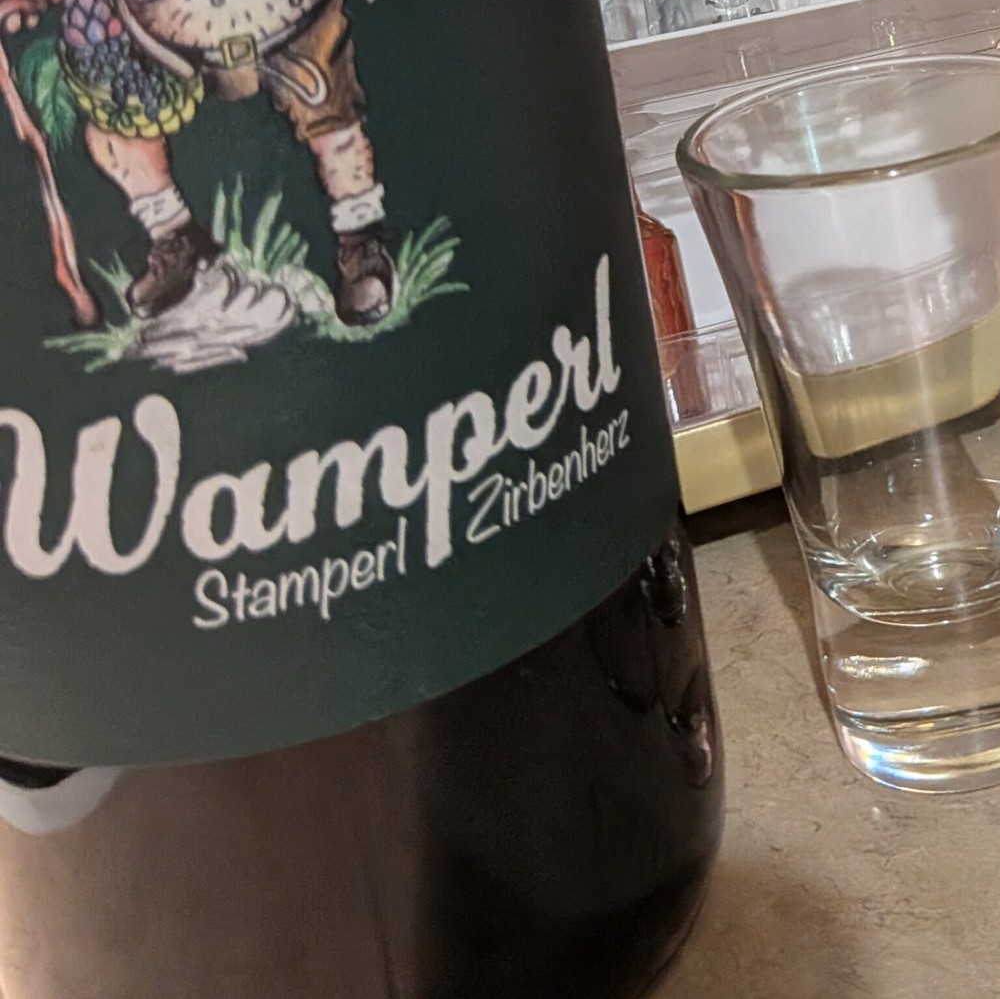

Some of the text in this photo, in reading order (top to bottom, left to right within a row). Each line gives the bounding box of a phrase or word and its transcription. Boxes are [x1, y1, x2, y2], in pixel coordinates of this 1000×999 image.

[0, 253, 622, 579] Wamperl
[192, 409, 631, 629] Stamperl Zirbenherz
